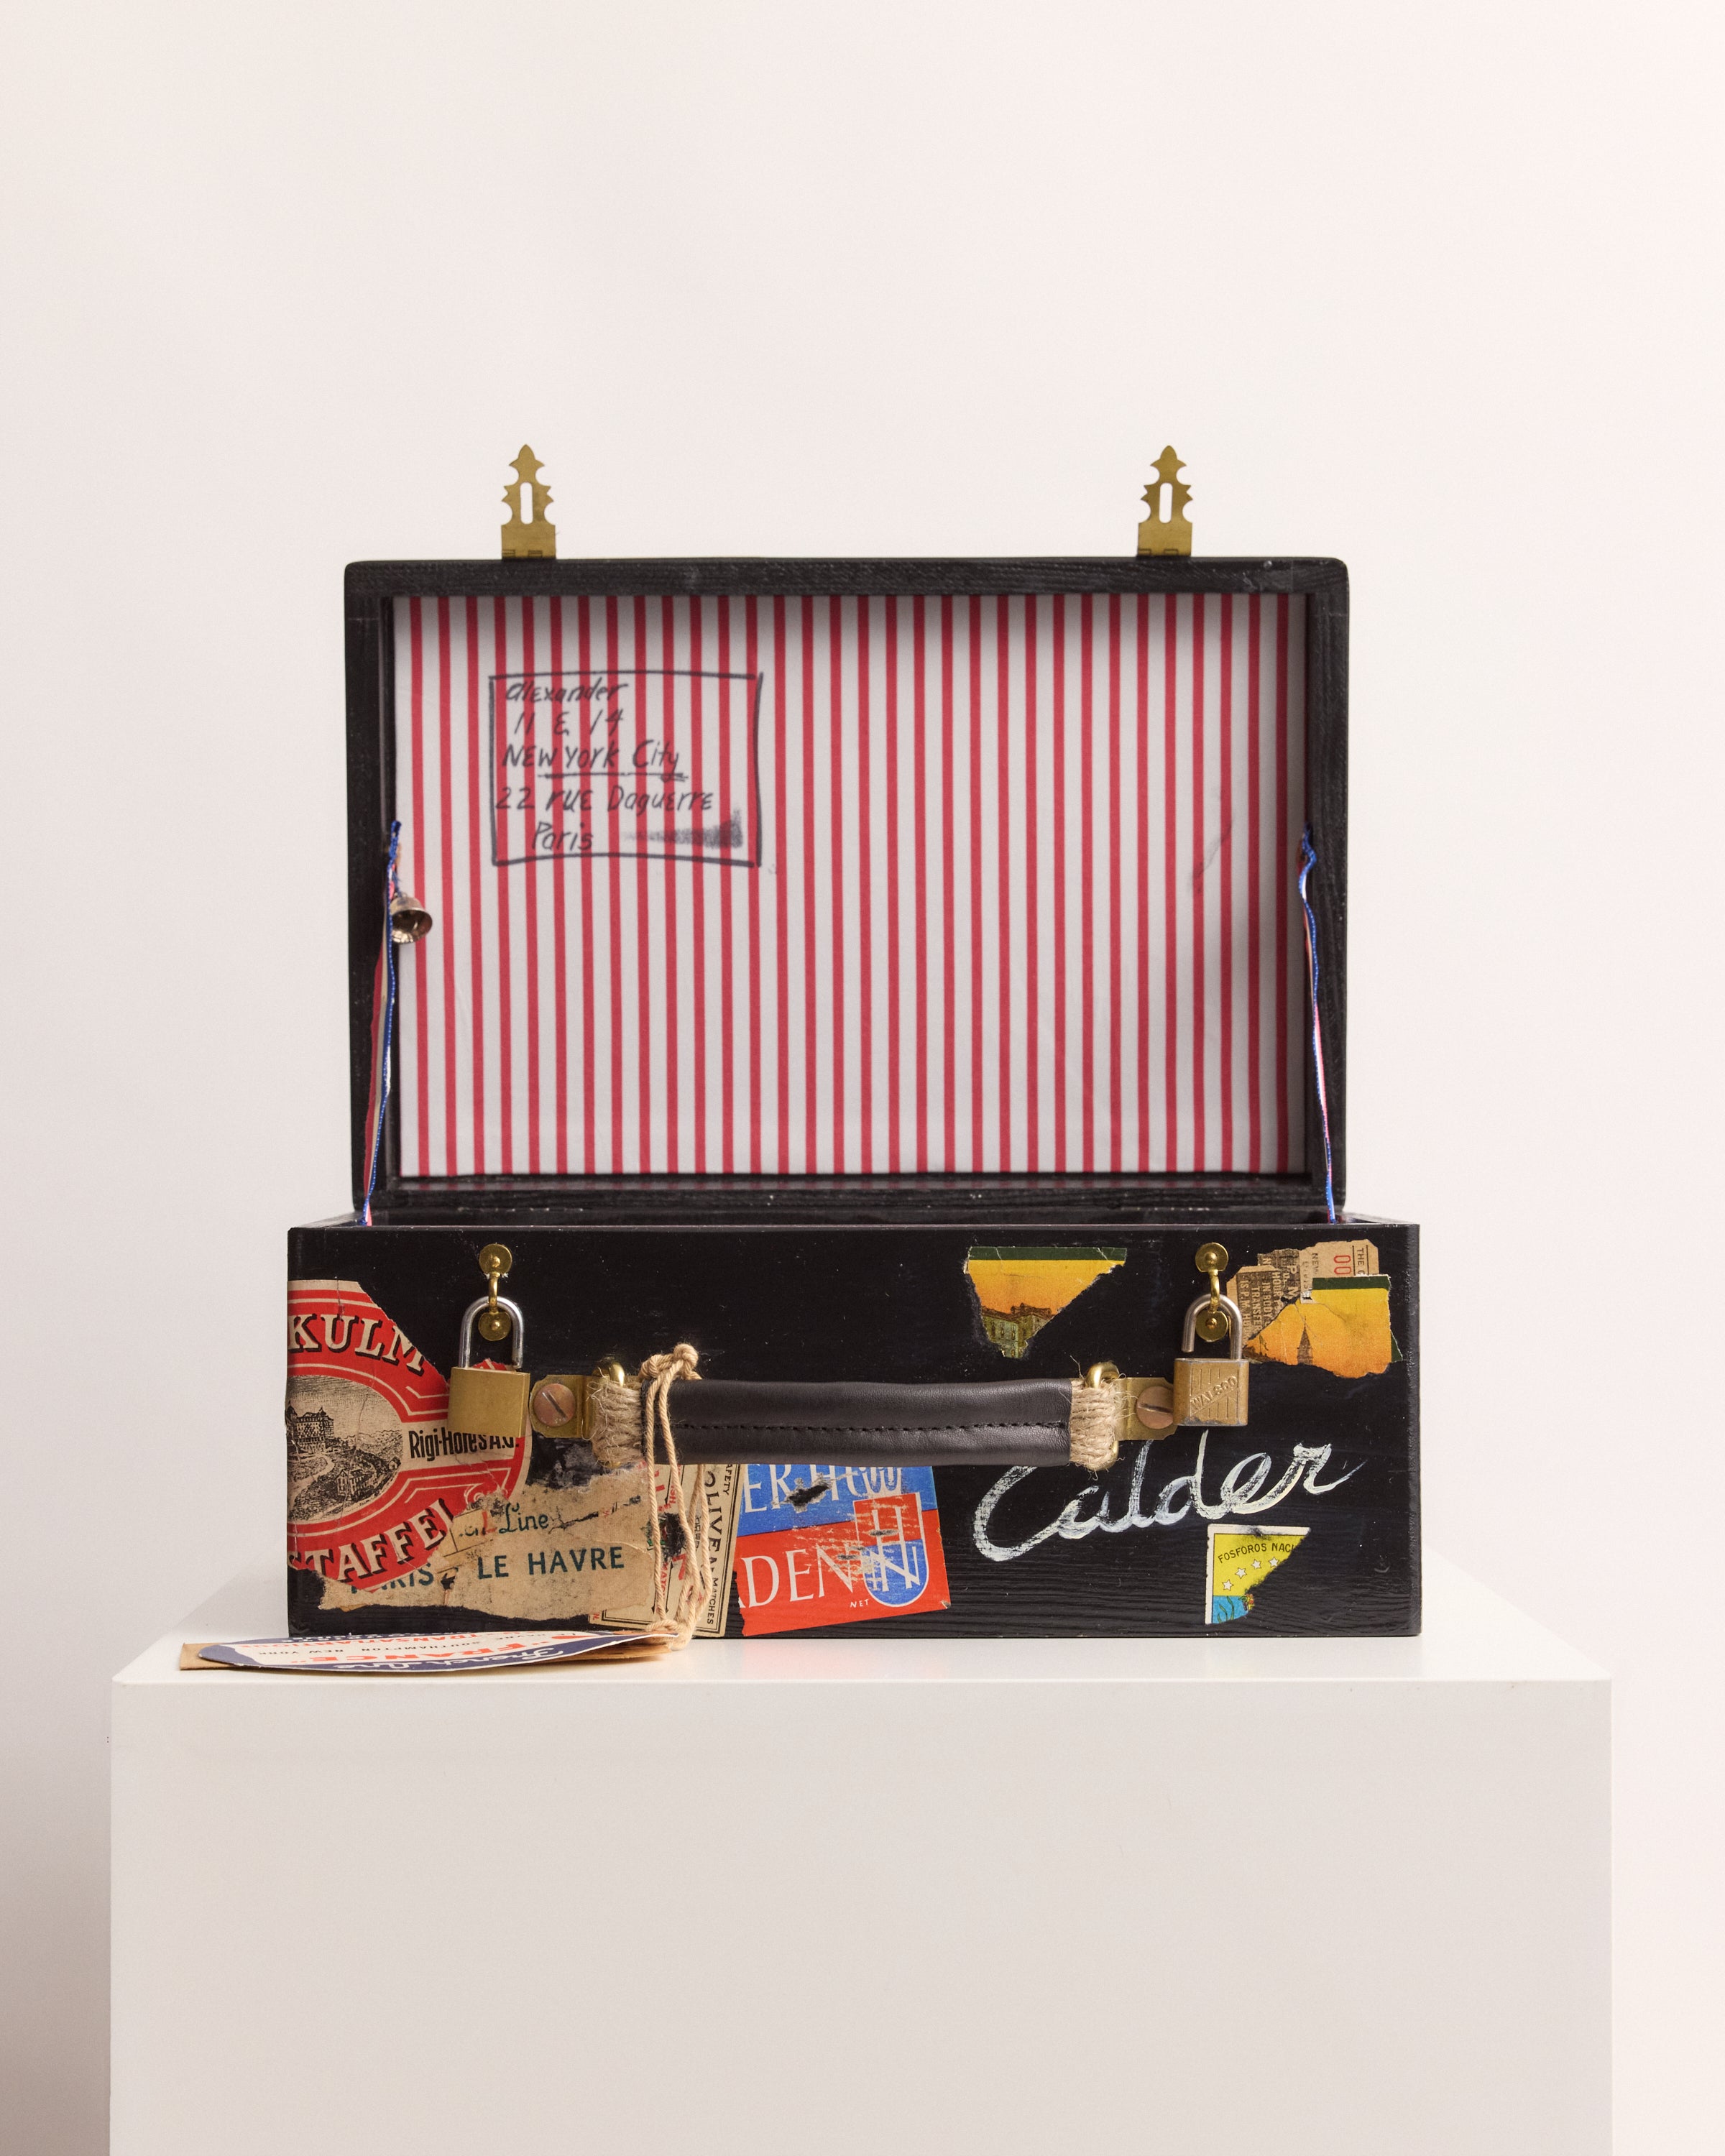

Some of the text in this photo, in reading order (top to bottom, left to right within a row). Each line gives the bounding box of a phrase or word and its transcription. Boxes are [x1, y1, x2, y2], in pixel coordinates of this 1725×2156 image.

[514, 711, 535, 735] 11
[590, 708, 624, 737] 14
[632, 740, 680, 773] City
[495, 786, 535, 811] 22
[531, 821, 594, 851] Paris
[1356, 1248, 1365, 1266] THE
[288, 1312, 426, 1377] KULM
[972, 1428, 1366, 1562] Calder
[498, 1502, 549, 1534] Line
[477, 1554, 510, 1580] LE
[528, 1546, 625, 1575] HAVRE
[1218, 1543, 1267, 1564] FOSFOROS
[707, 1577, 719, 1626] MATCHES
[850, 1598, 870, 1608] NET
